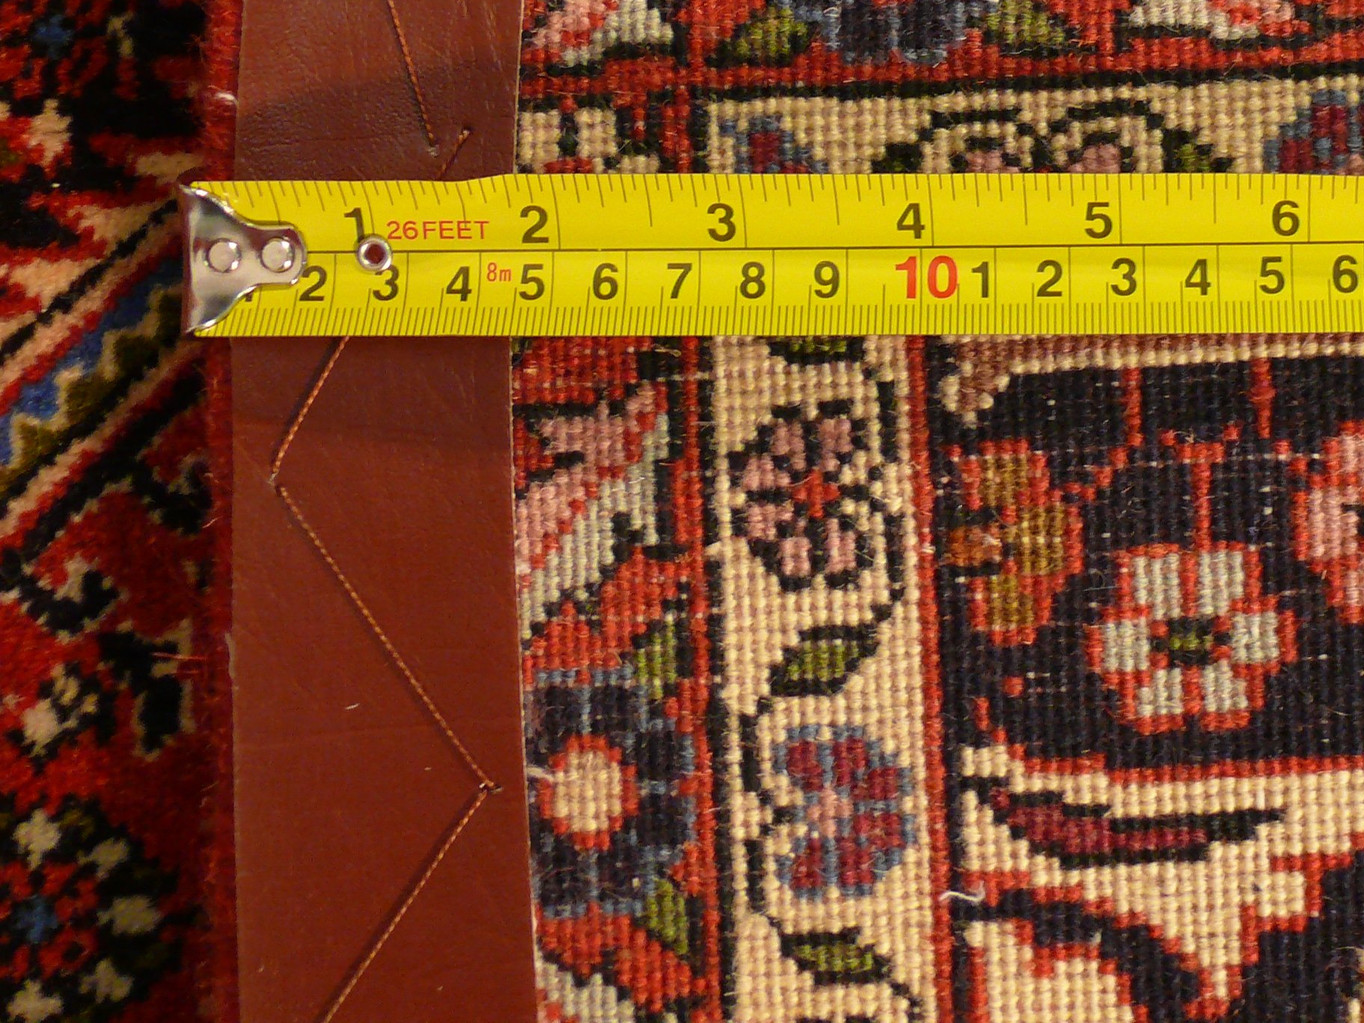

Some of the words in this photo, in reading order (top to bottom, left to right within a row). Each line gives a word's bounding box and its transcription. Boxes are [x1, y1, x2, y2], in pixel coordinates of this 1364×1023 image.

[344, 207, 366, 244] 1
[520, 205, 549, 244] 2
[707, 203, 736, 241] 3
[897, 203, 925, 239] 4
[1085, 201, 1113, 239] 5
[1271, 200, 1300, 236] 6
[300, 266, 326, 302] 2
[372, 269, 399, 302] 3
[445, 267, 472, 302] 4
[519, 264, 546, 300] 5
[592, 264, 620, 300] 6
[668, 263, 693, 299] 7
[739, 262, 766, 299] 8
[814, 261, 840, 299] 9
[895, 256, 958, 299] 10
[971, 261, 990, 298] 1
[1037, 260, 1063, 297] 2
[1111, 258, 1138, 296] 3
[1185, 259, 1212, 296] 4
[1259, 256, 1285, 294] 5
[1332, 255, 1359, 293] 6
[486, 263, 512, 282] 8m
